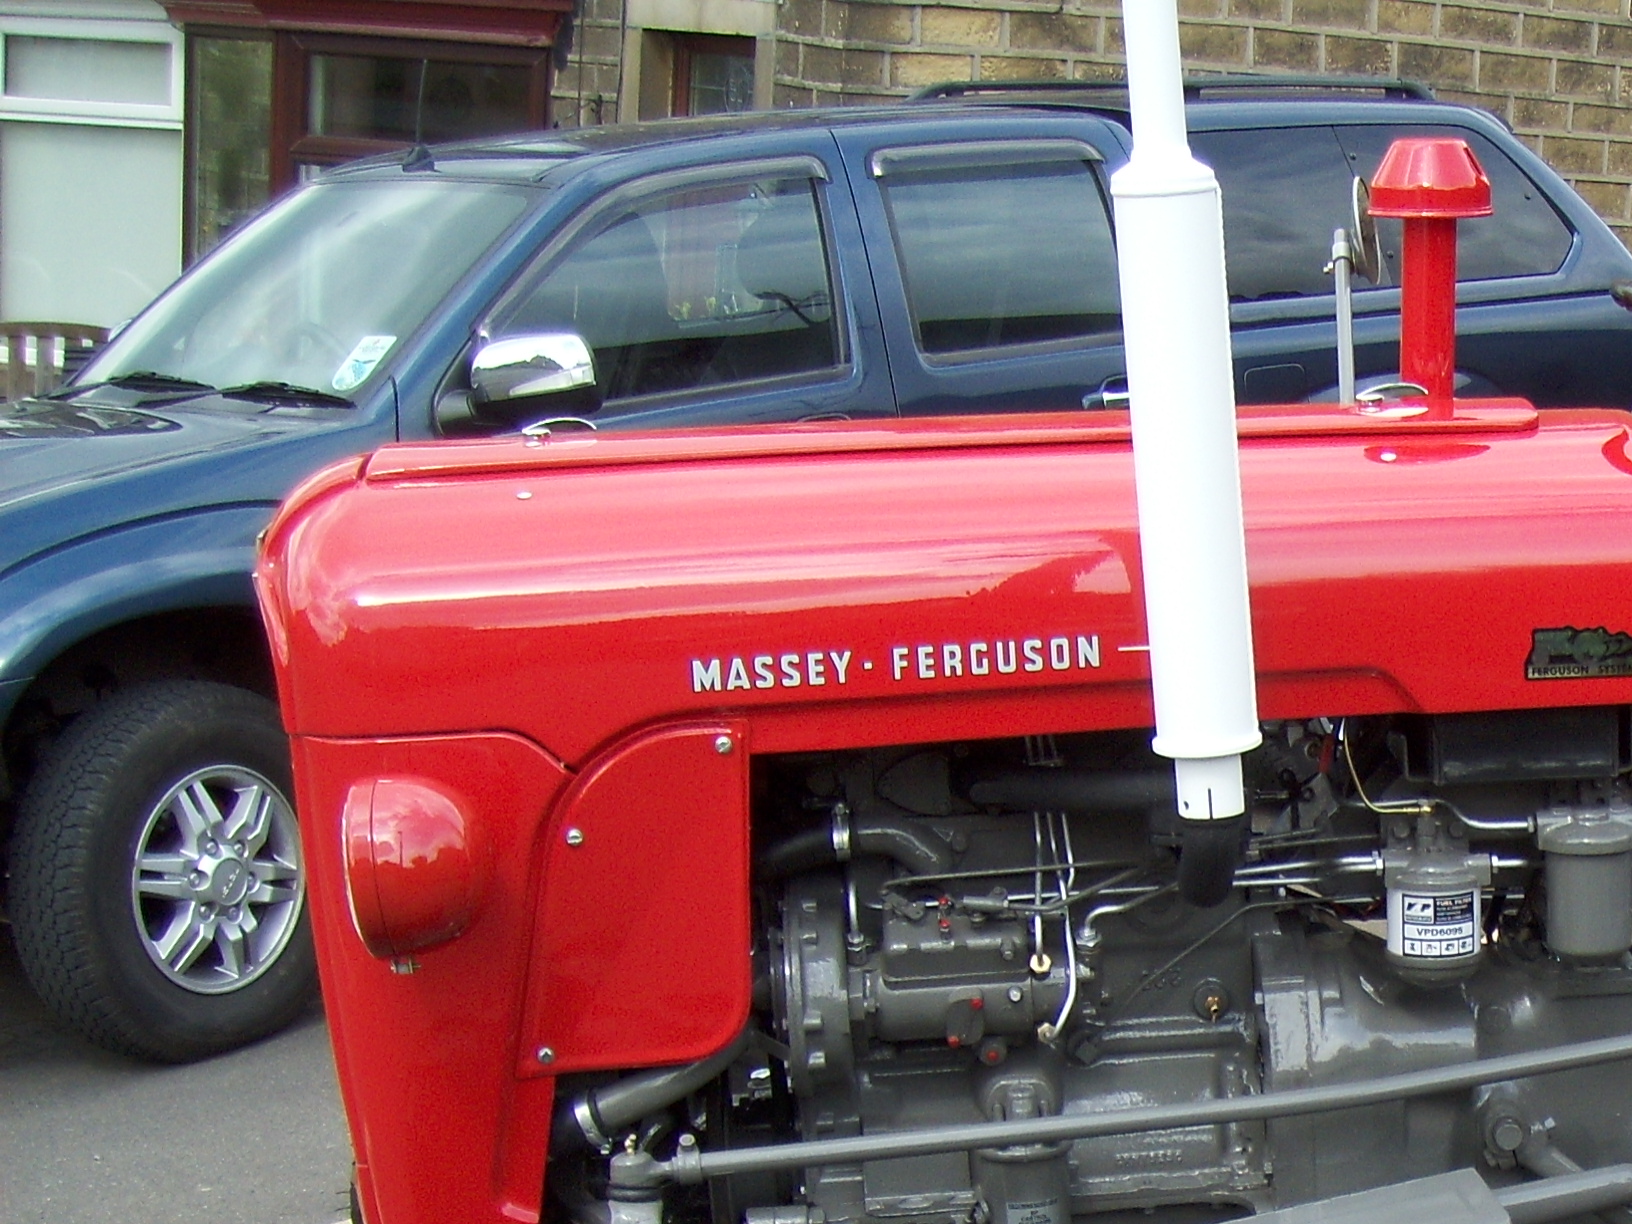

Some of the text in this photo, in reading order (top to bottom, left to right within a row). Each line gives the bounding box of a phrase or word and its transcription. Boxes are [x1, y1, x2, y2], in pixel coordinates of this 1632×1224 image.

[691, 635, 1102, 693] MASSEY FERGUSON
[1531, 665, 1589, 677] FERGUSON
[1416, 926, 1463, 938] VPD6095
